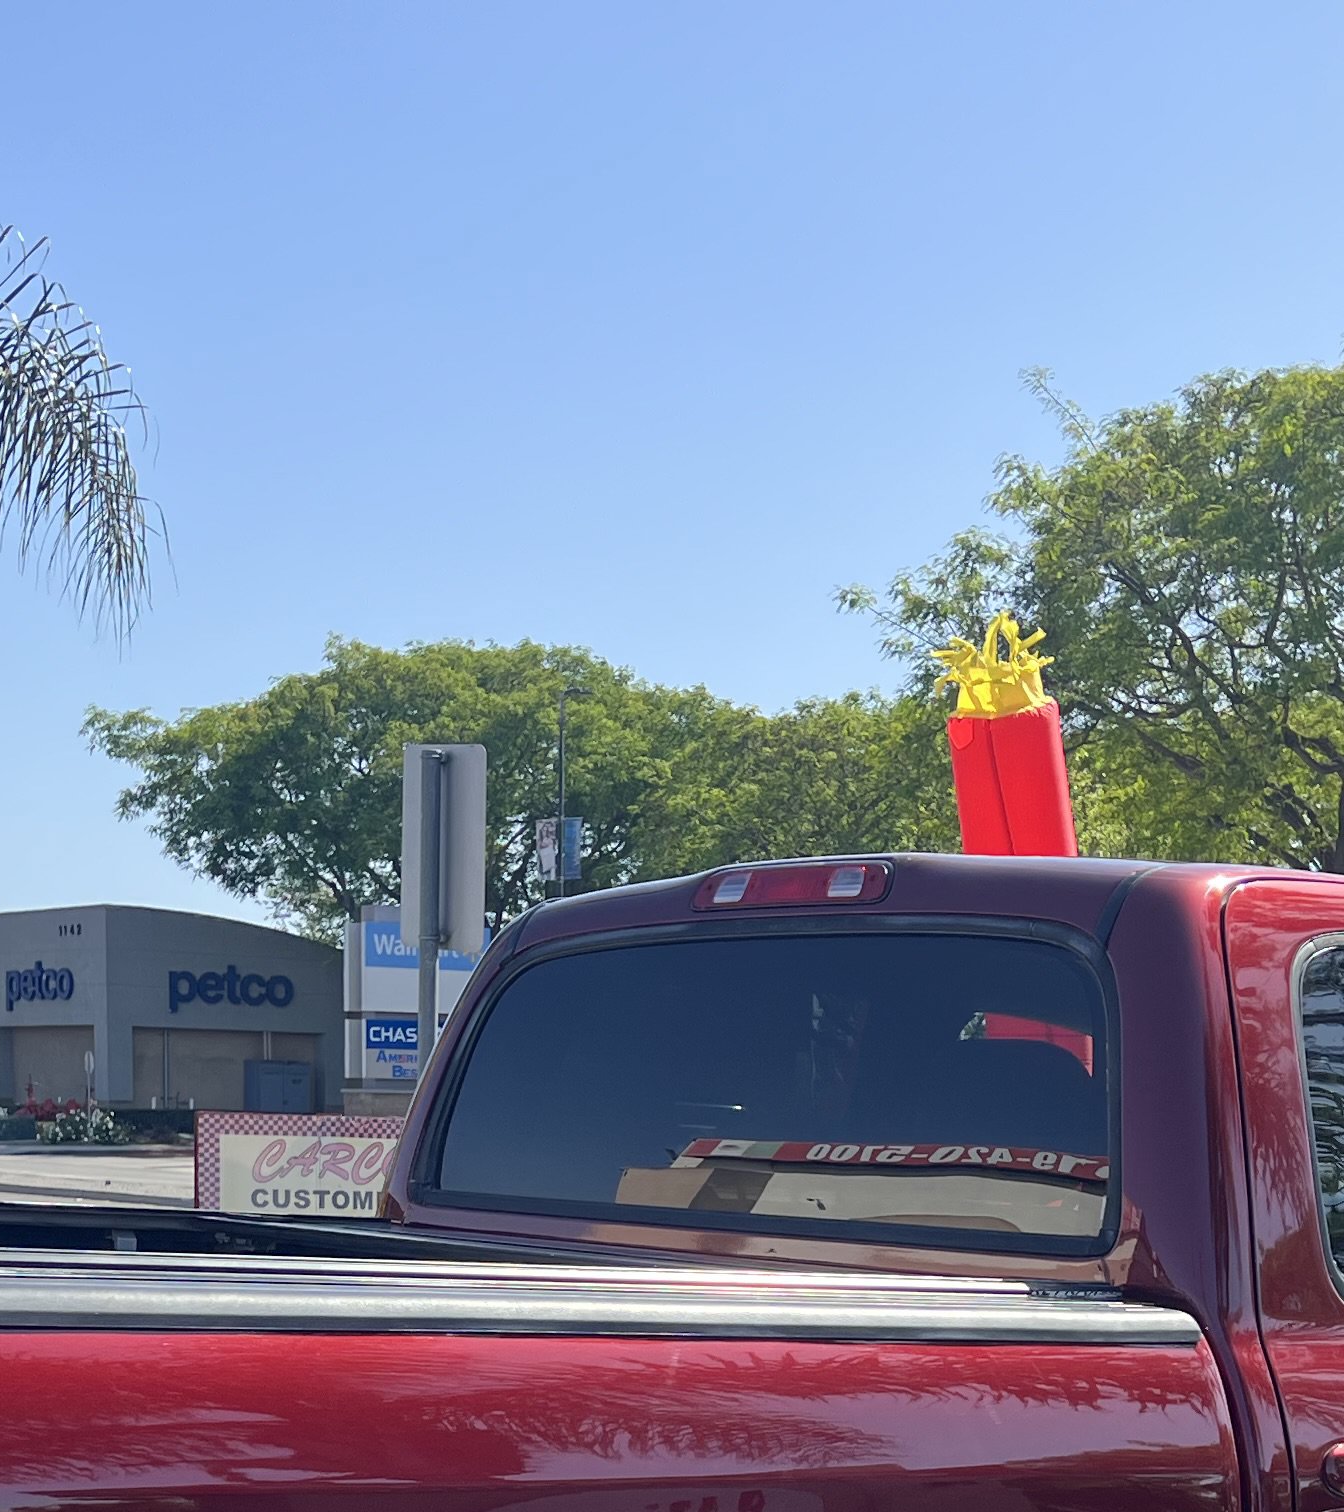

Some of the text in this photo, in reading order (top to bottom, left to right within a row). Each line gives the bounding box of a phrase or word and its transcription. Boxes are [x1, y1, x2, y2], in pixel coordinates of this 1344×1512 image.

[58, 923, 82, 937] 1142
[6, 960, 75, 1011] petco
[167, 964, 295, 1014] petco
[369, 1026, 418, 1044] CHAS
[376, 1050, 417, 1064] AMERI
[392, 1065, 417, 1078] BES
